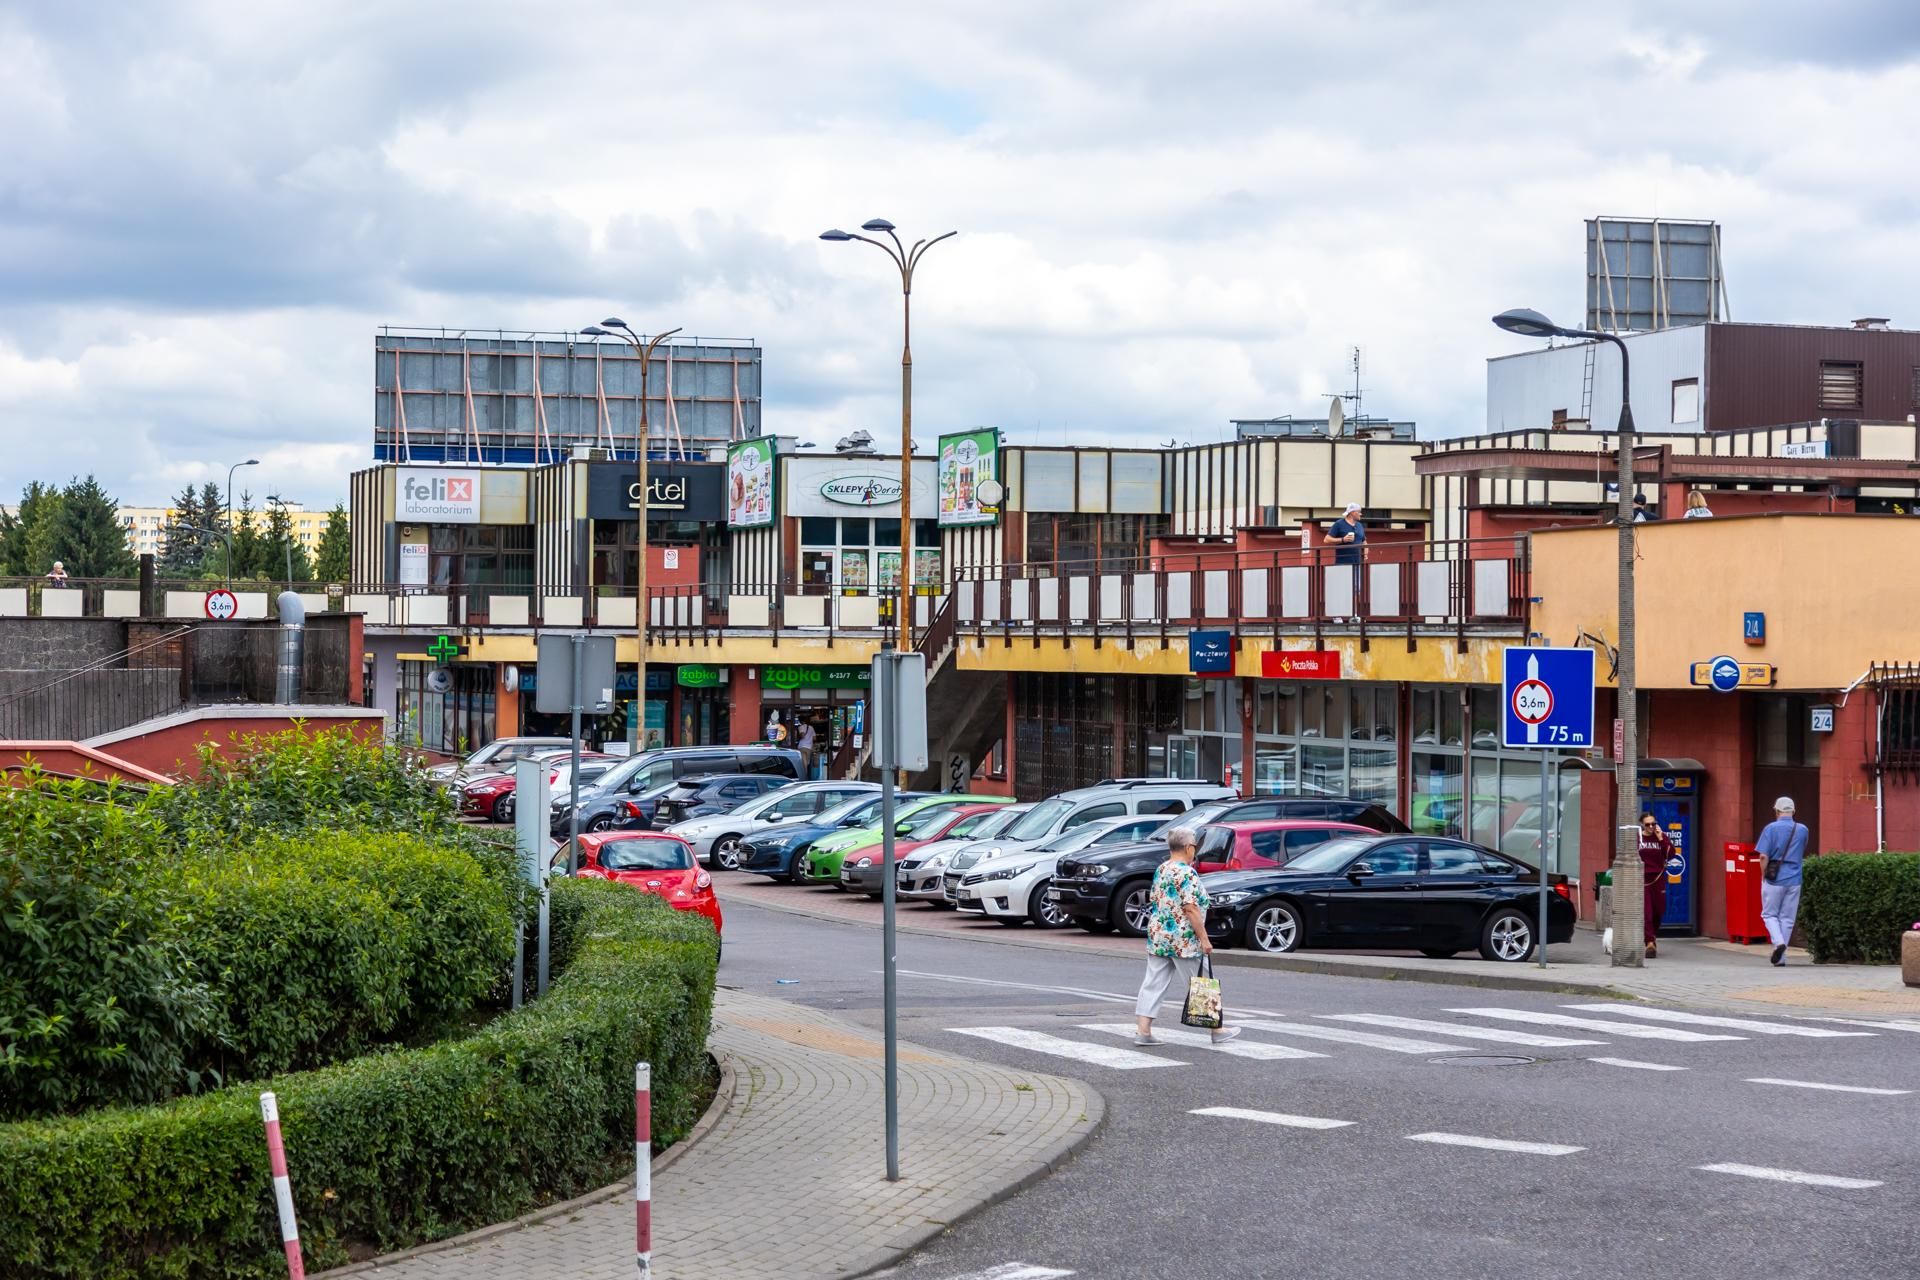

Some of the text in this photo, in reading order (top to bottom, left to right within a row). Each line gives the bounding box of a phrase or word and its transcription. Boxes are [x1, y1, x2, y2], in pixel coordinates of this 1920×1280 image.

[827, 485, 863, 493] SKLEPY
[405, 501, 472, 515] laboratorium
[1746, 619, 1759, 637] 2/4
[1195, 650, 1229, 658] Pocztowy
[766, 667, 821, 682] żabka
[1814, 716, 1831, 729] 2/4
[1549, 726, 1583, 742] 75 m
